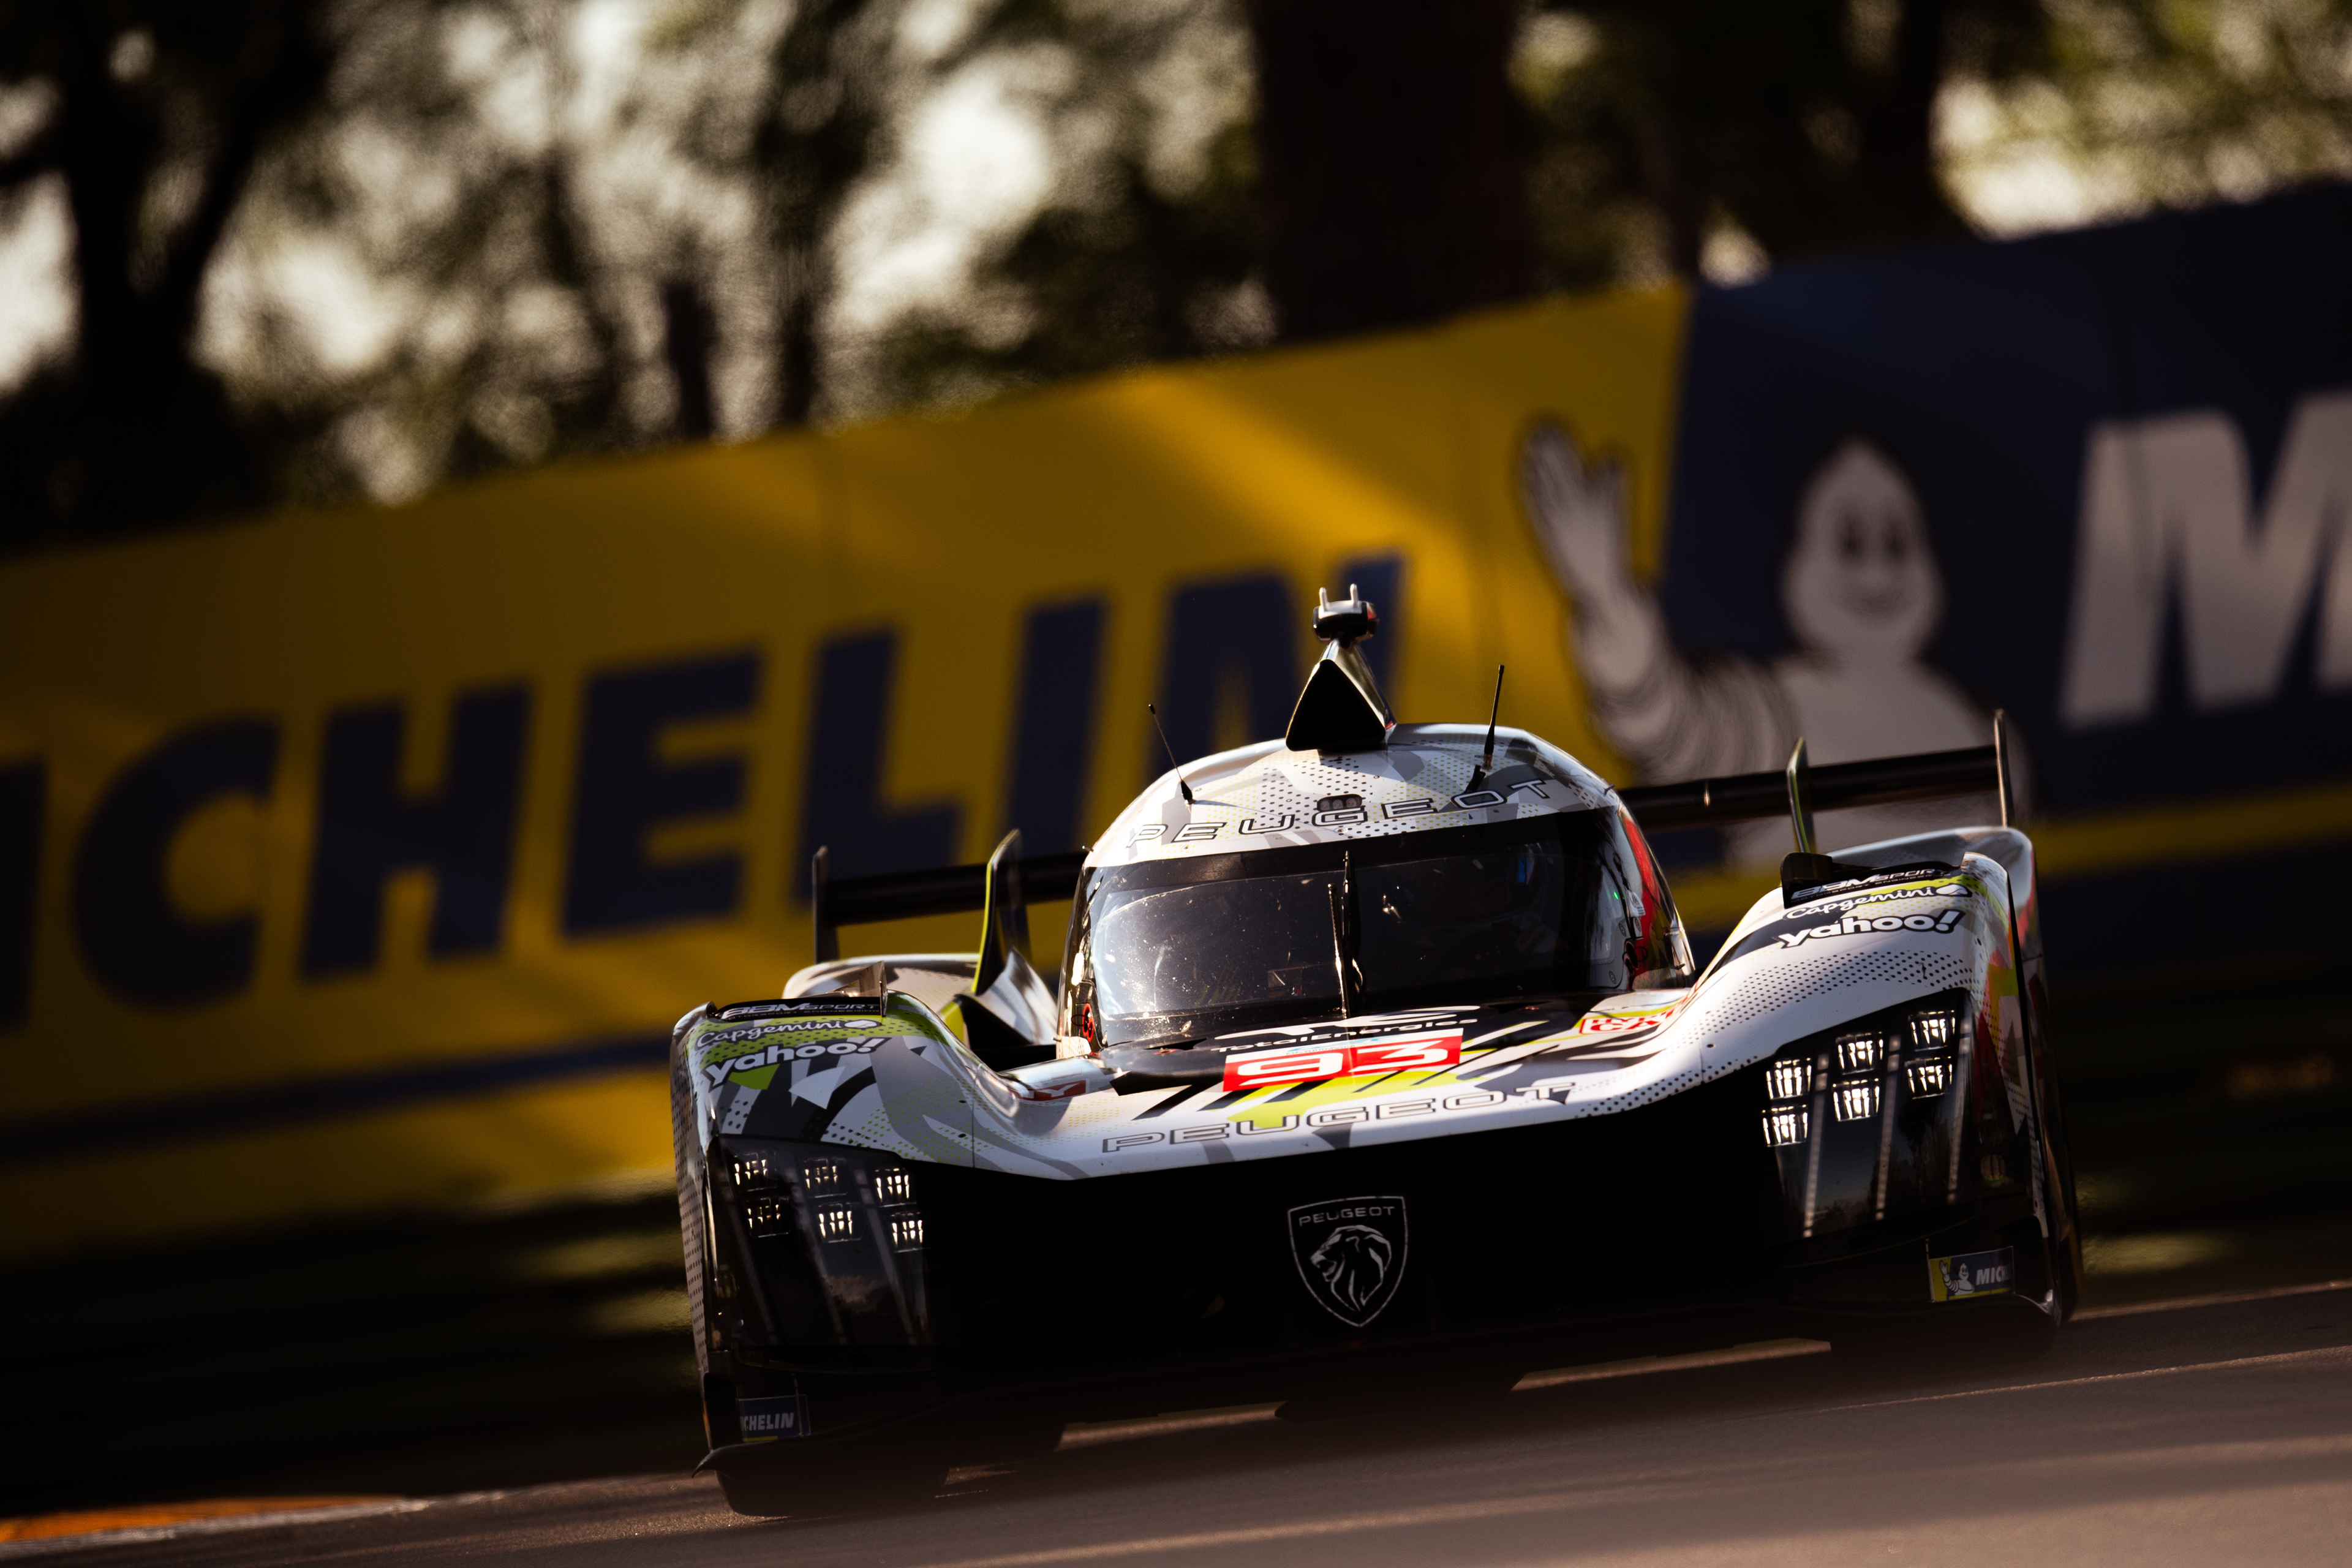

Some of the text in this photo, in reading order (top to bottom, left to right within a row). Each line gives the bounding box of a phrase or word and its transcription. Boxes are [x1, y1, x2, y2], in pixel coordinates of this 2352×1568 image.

[1125, 779, 1550, 848] PEUGEOT
[1786, 887, 1935, 919] Capgemini
[1779, 910, 1960, 948] yahoo!
[697, 1020, 842, 1047] Capgemini
[1210, 1018, 1478, 1052] TotalEnergies
[705, 1038, 886, 1088] yahoo!
[1237, 1040, 1449, 1086] 93
[1102, 1082, 1577, 1154] PEUGEOT
[1298, 1206, 1395, 1226] PEUGEOT
